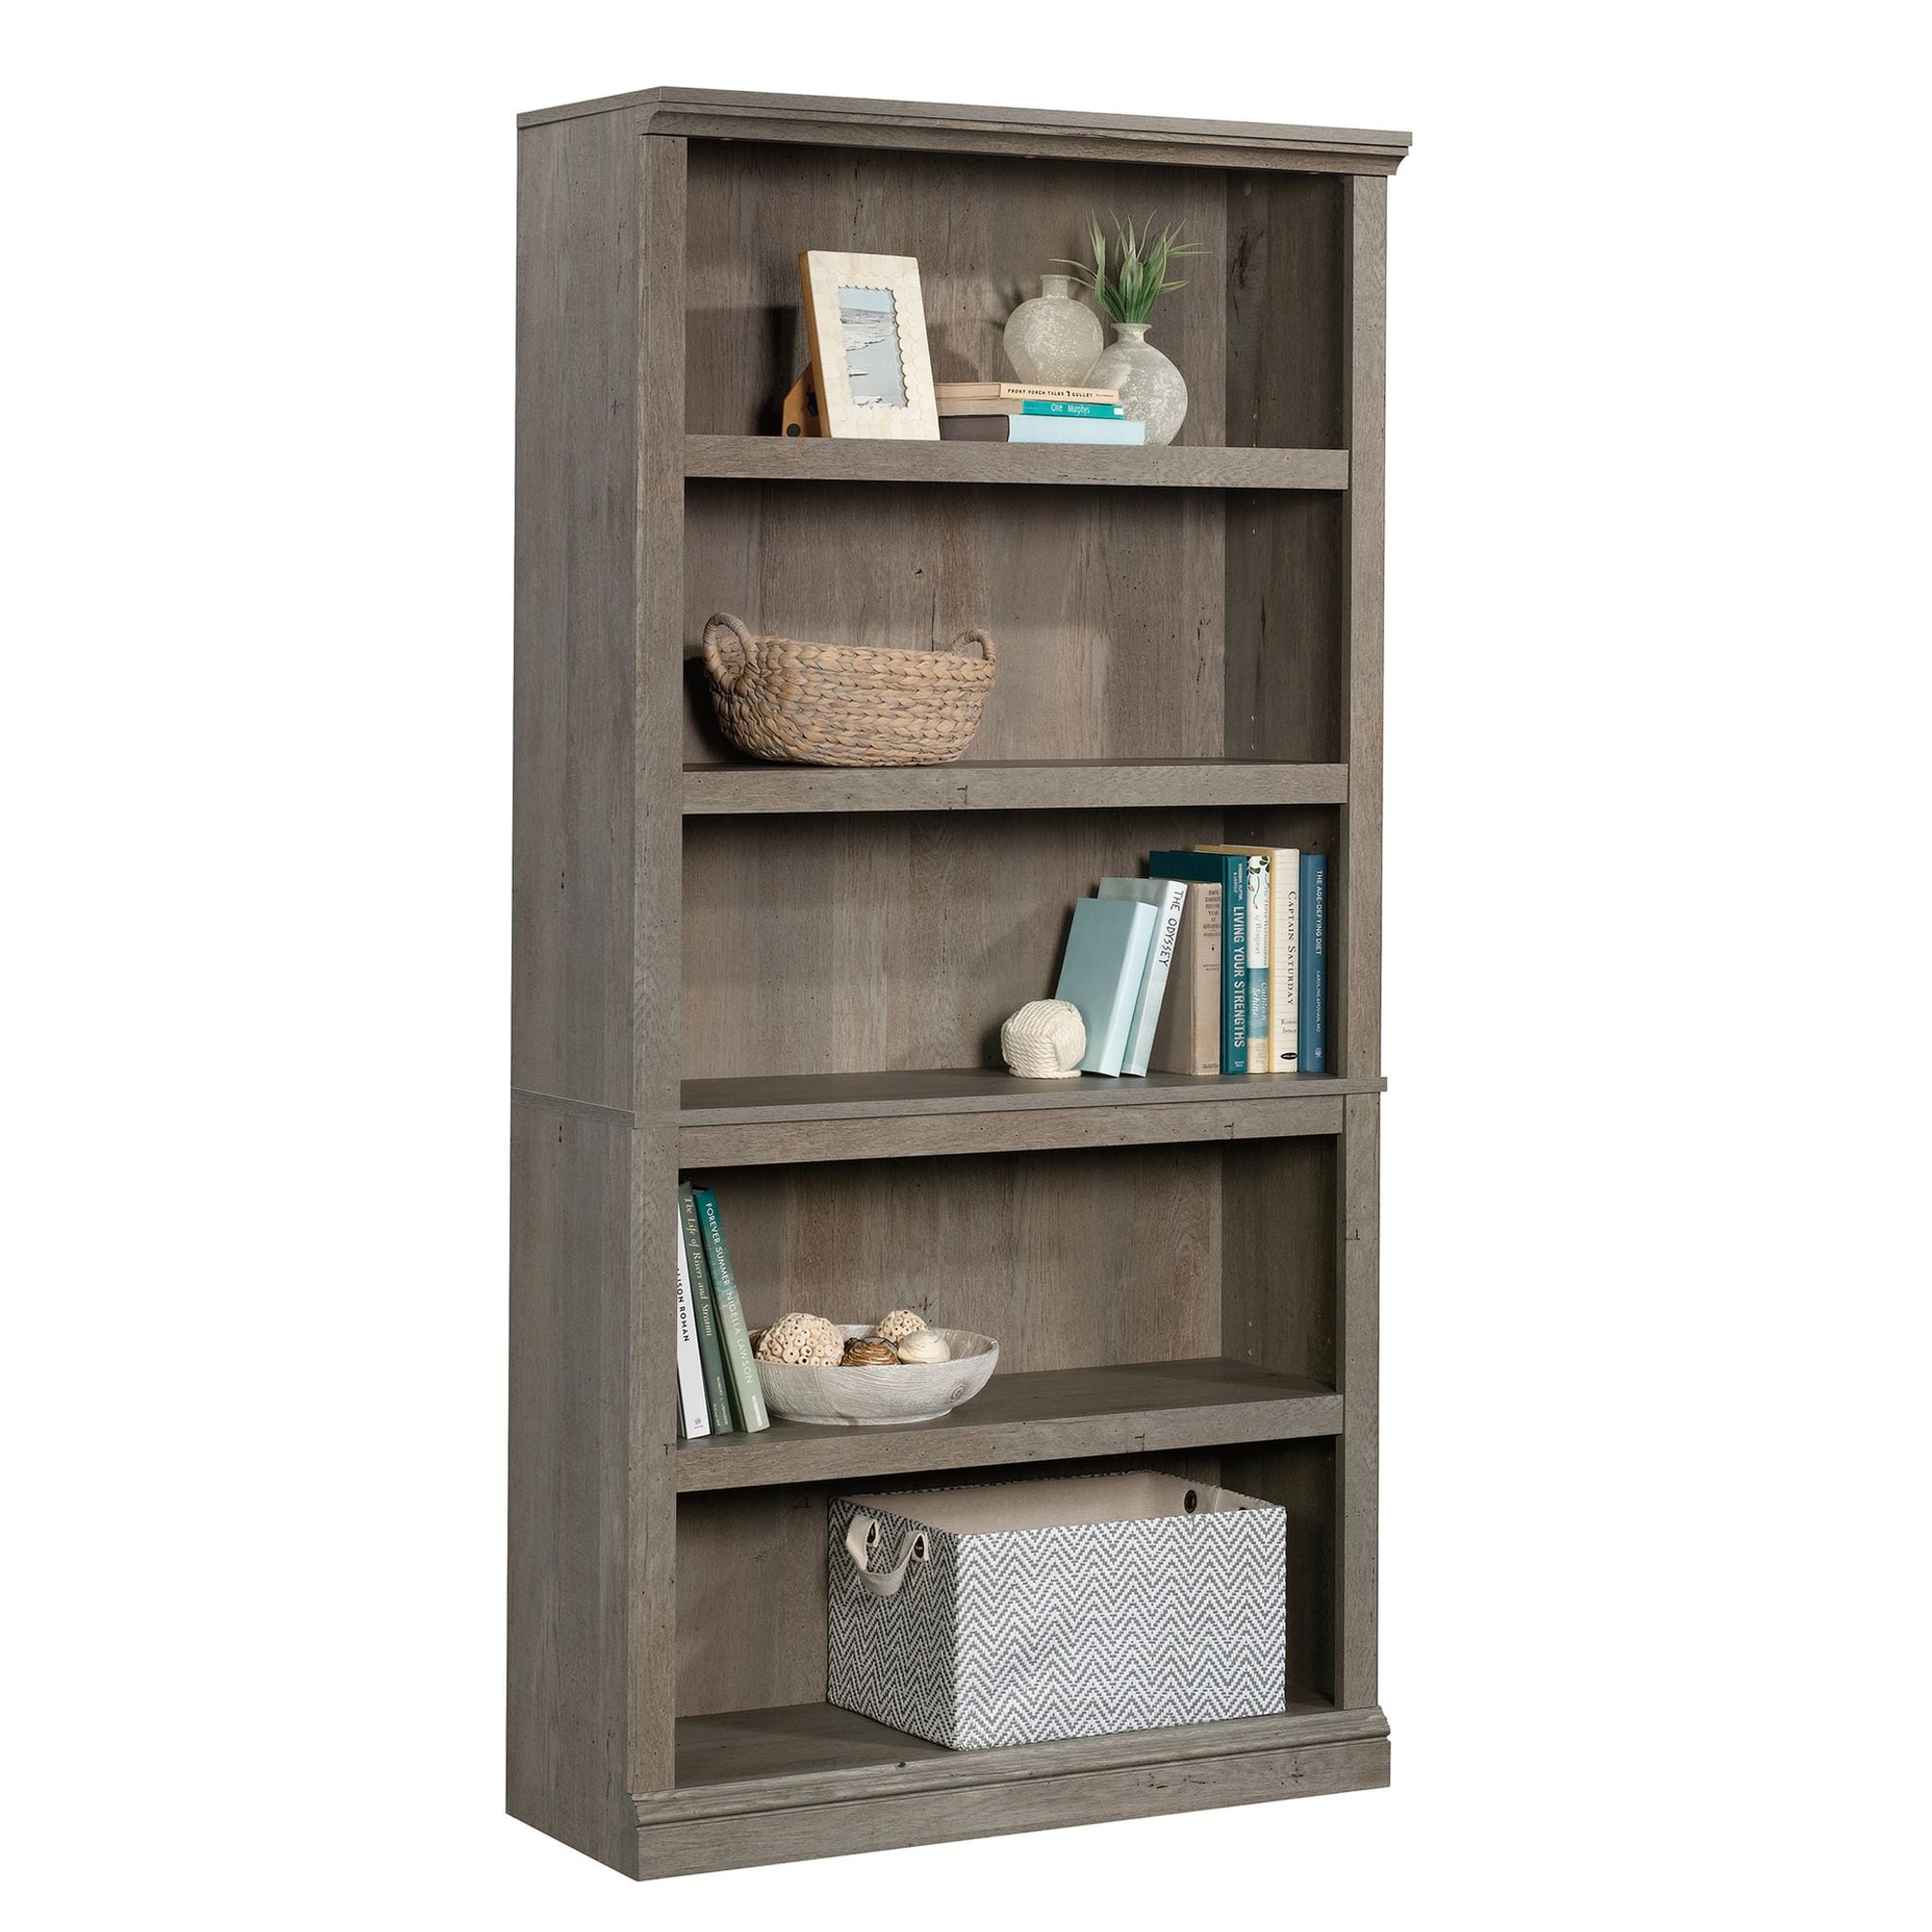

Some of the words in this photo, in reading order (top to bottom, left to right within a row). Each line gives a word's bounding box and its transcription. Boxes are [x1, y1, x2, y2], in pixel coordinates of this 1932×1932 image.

[1051, 403, 1063, 412] One
[1067, 405, 1091, 415] Murphys
[1170, 891, 1184, 911] THE
[1288, 891, 1296, 940] CAPTAIN
[1233, 906, 1244, 944] LIVING
[1158, 918, 1178, 967] ODYSSEY
[1234, 947, 1244, 978] YOUR
[1287, 946, 1295, 1005] SATURDAY
[1234, 980, 1244, 1048] STRENGTHS
[686, 1218, 696, 1236] Life
[689, 1238, 699, 1248] of
[705, 1203, 721, 1244] FOREVER
[716, 1246, 730, 1287] SUMMER
[693, 1252, 701, 1279] Rivers
[697, 1282, 708, 1300] and
[679, 1306, 690, 1342] ROMAN
[701, 1304, 712, 1336] Streams
[725, 1292, 740, 1334] NIGELLA
[736, 1337, 753, 1384] LAWSON
